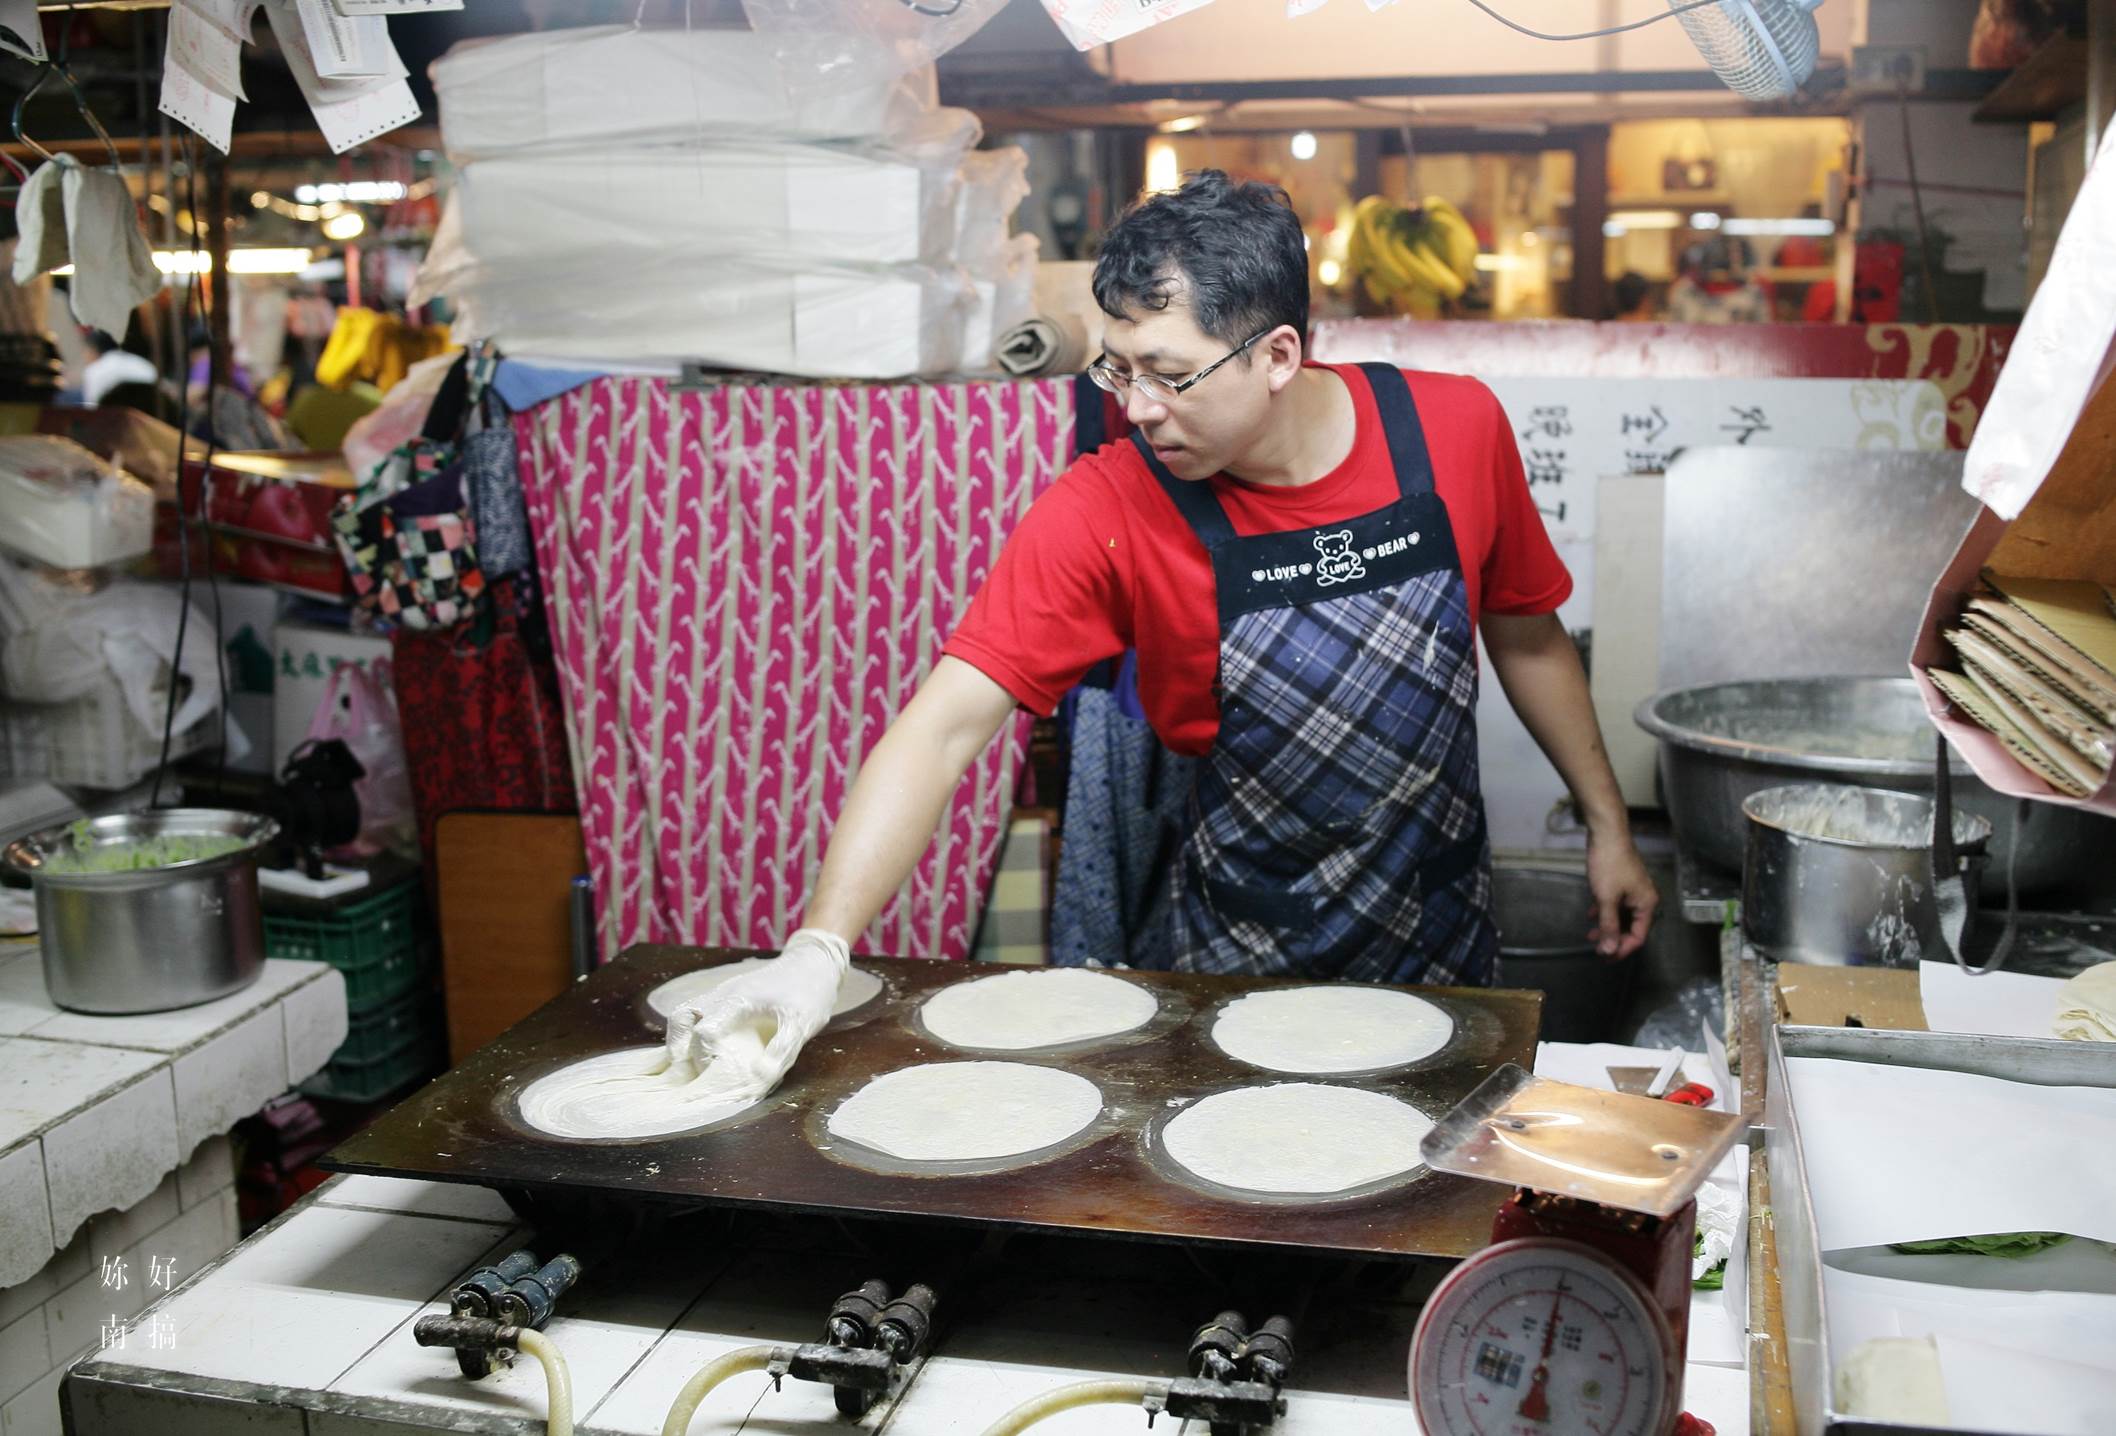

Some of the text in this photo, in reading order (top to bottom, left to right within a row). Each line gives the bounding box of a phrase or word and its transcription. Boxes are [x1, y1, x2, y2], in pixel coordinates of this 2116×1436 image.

[1266, 538, 1408, 582] LOVE BEAR
[1329, 561, 1351, 575] LOVE
